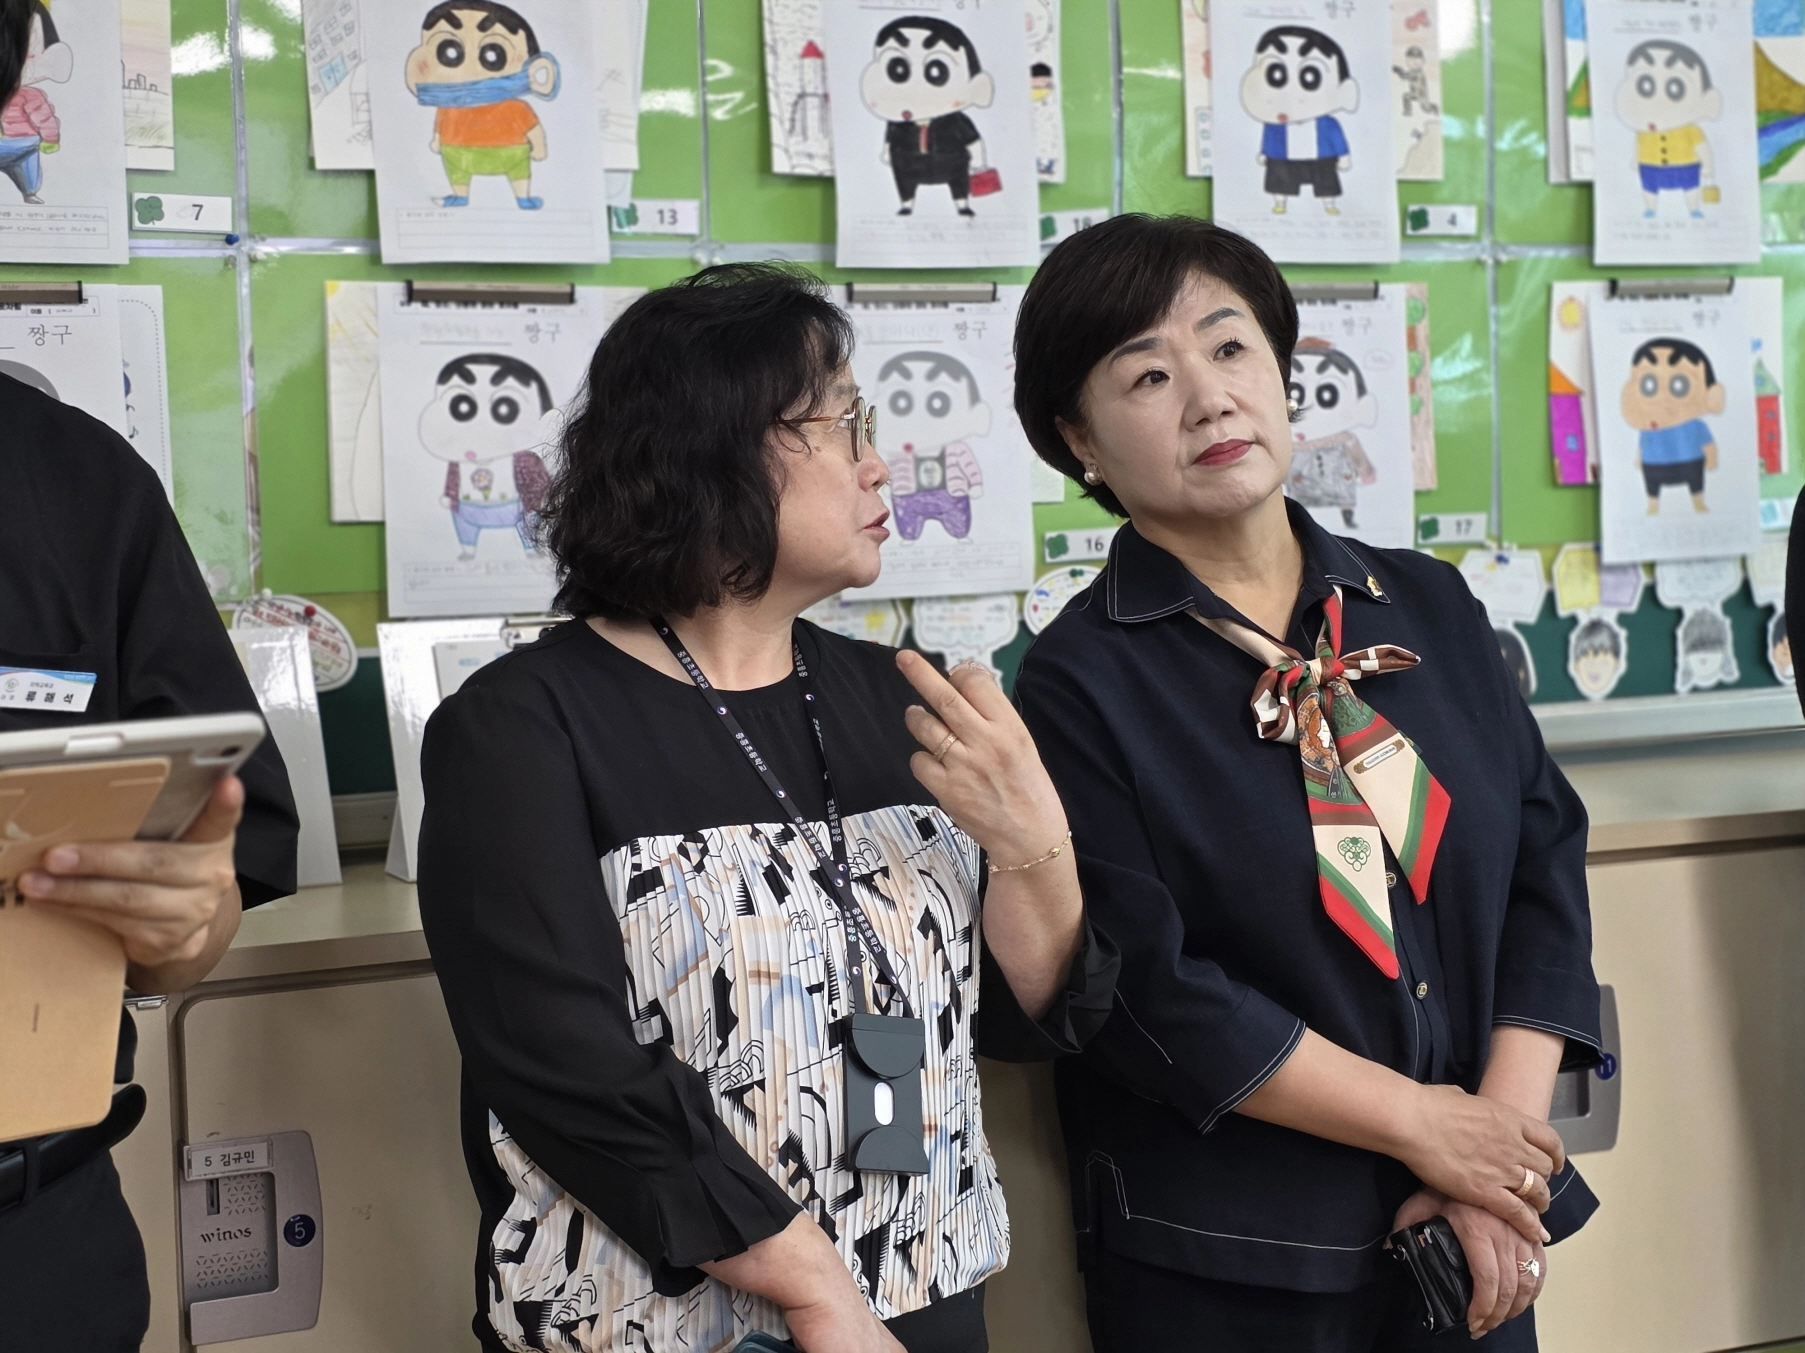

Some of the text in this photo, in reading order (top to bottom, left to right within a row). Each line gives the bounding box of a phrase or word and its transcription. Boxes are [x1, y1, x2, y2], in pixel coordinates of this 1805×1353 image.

[192, 204, 204, 221] 7
[657, 208, 679, 226] 13
[1447, 211, 1457, 227] 4
[27, 323, 73, 347] 짱구
[1456, 518, 1473, 535] 17
[1086, 536, 1104, 552] 16
[204, 1149, 255, 1167] 5 김규민
[200, 1227, 252, 1243] winos
[294, 1221, 306, 1240] 5
